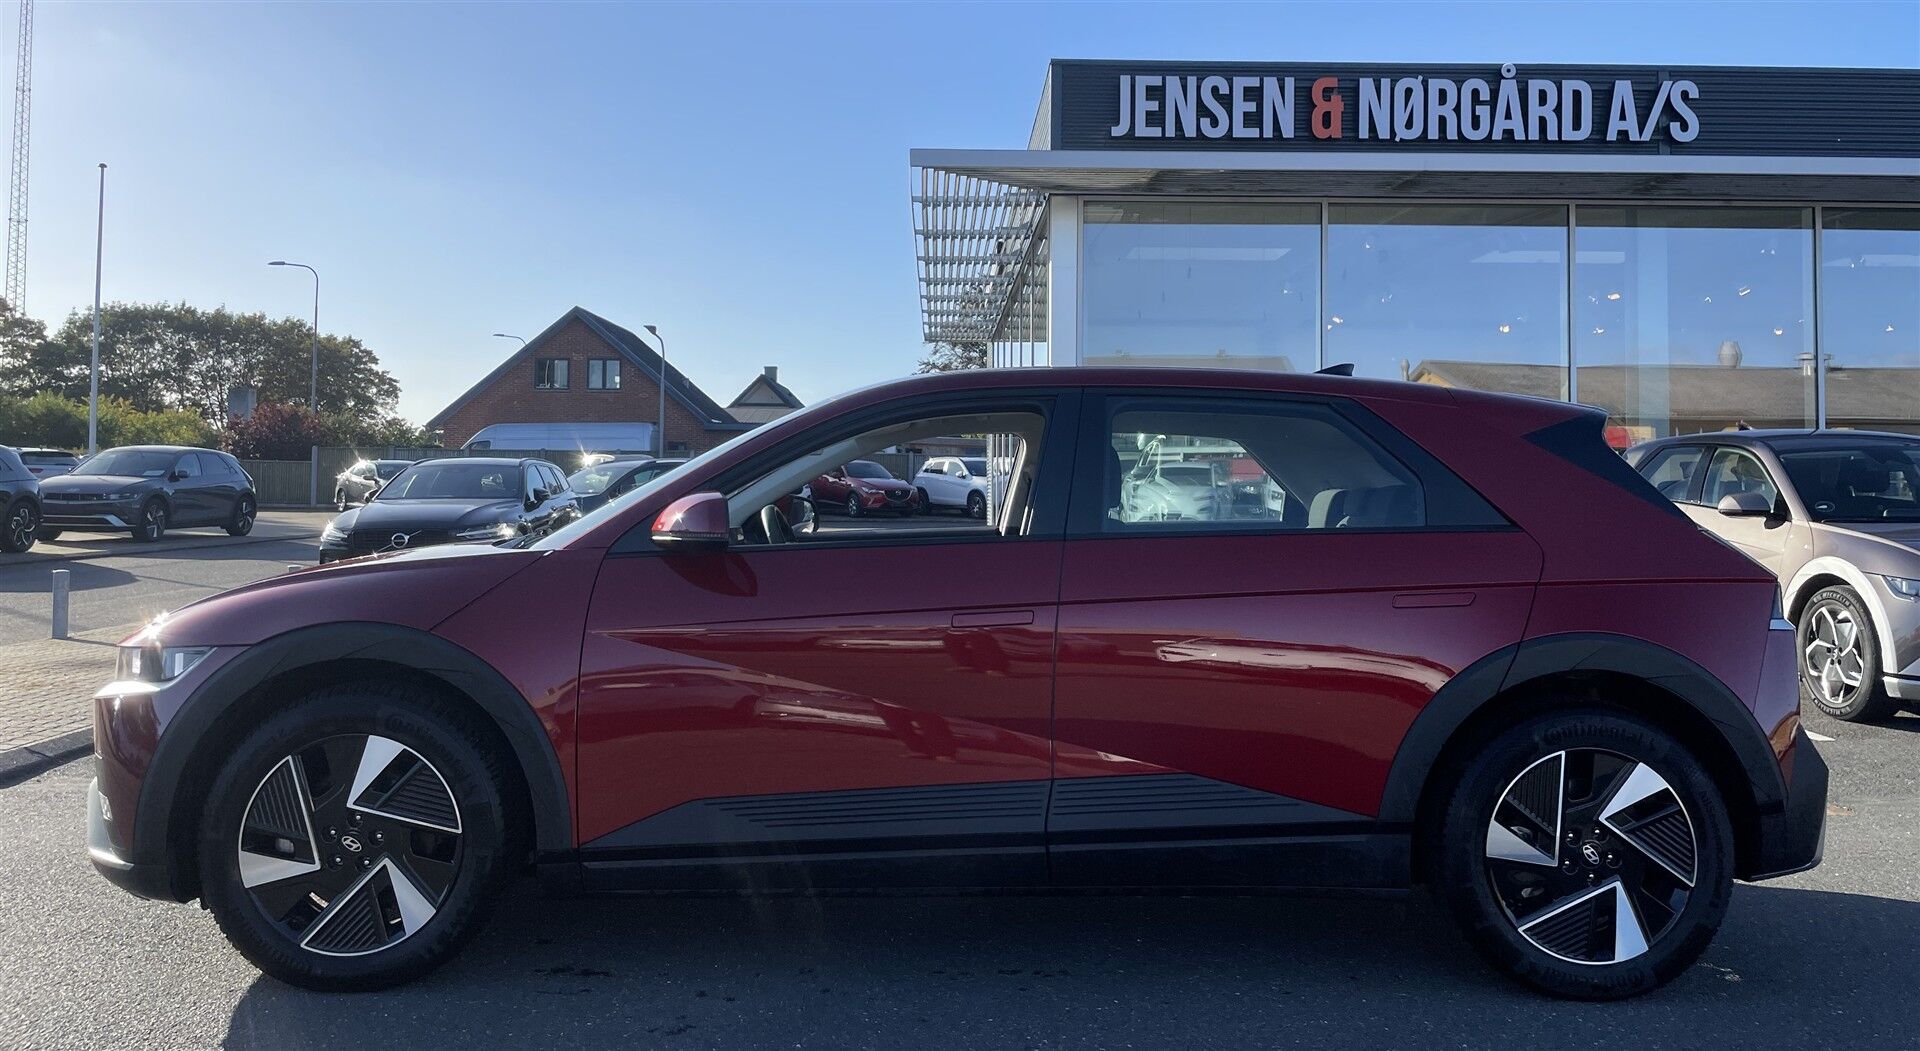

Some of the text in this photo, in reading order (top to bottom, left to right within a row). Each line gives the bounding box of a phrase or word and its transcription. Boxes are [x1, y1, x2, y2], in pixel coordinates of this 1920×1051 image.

[1111, 62, 1700, 143] JENSEN & NØRGÅRD A/S
